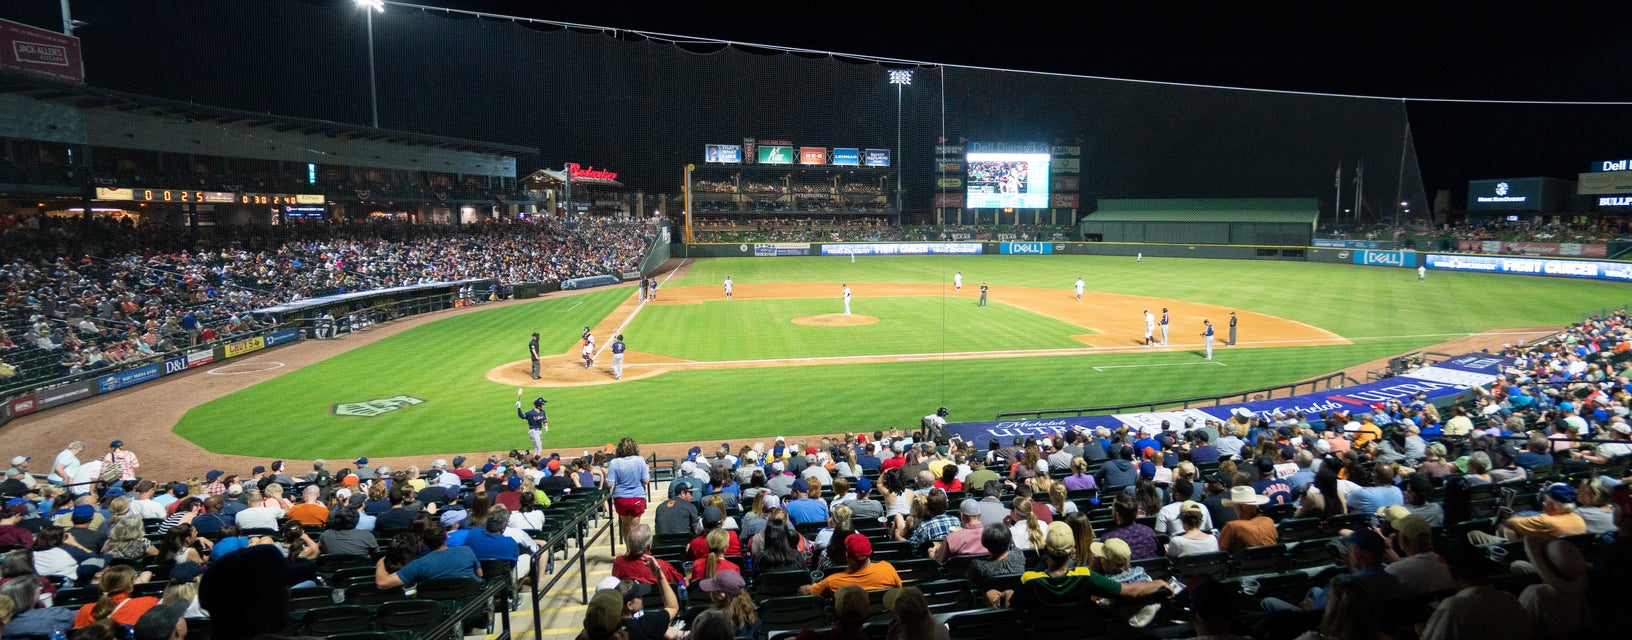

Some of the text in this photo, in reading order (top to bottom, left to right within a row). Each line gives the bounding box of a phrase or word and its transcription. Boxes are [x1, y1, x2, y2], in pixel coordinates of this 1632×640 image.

[18, 44, 62, 56] JACK ALLEN'S
[973, 142, 994, 153] Dell
[569, 163, 618, 180] Budweiser
[1602, 159, 1627, 172] Dell
[1014, 244, 1039, 253] DELL
[1369, 252, 1400, 264] DELL
[1503, 260, 1540, 273] FIGHT
[1544, 262, 1598, 276] CANCER
[166, 358, 188, 374] D&L
[1348, 380, 1451, 403] ULTRA
[996, 418, 1066, 428] Michelob
